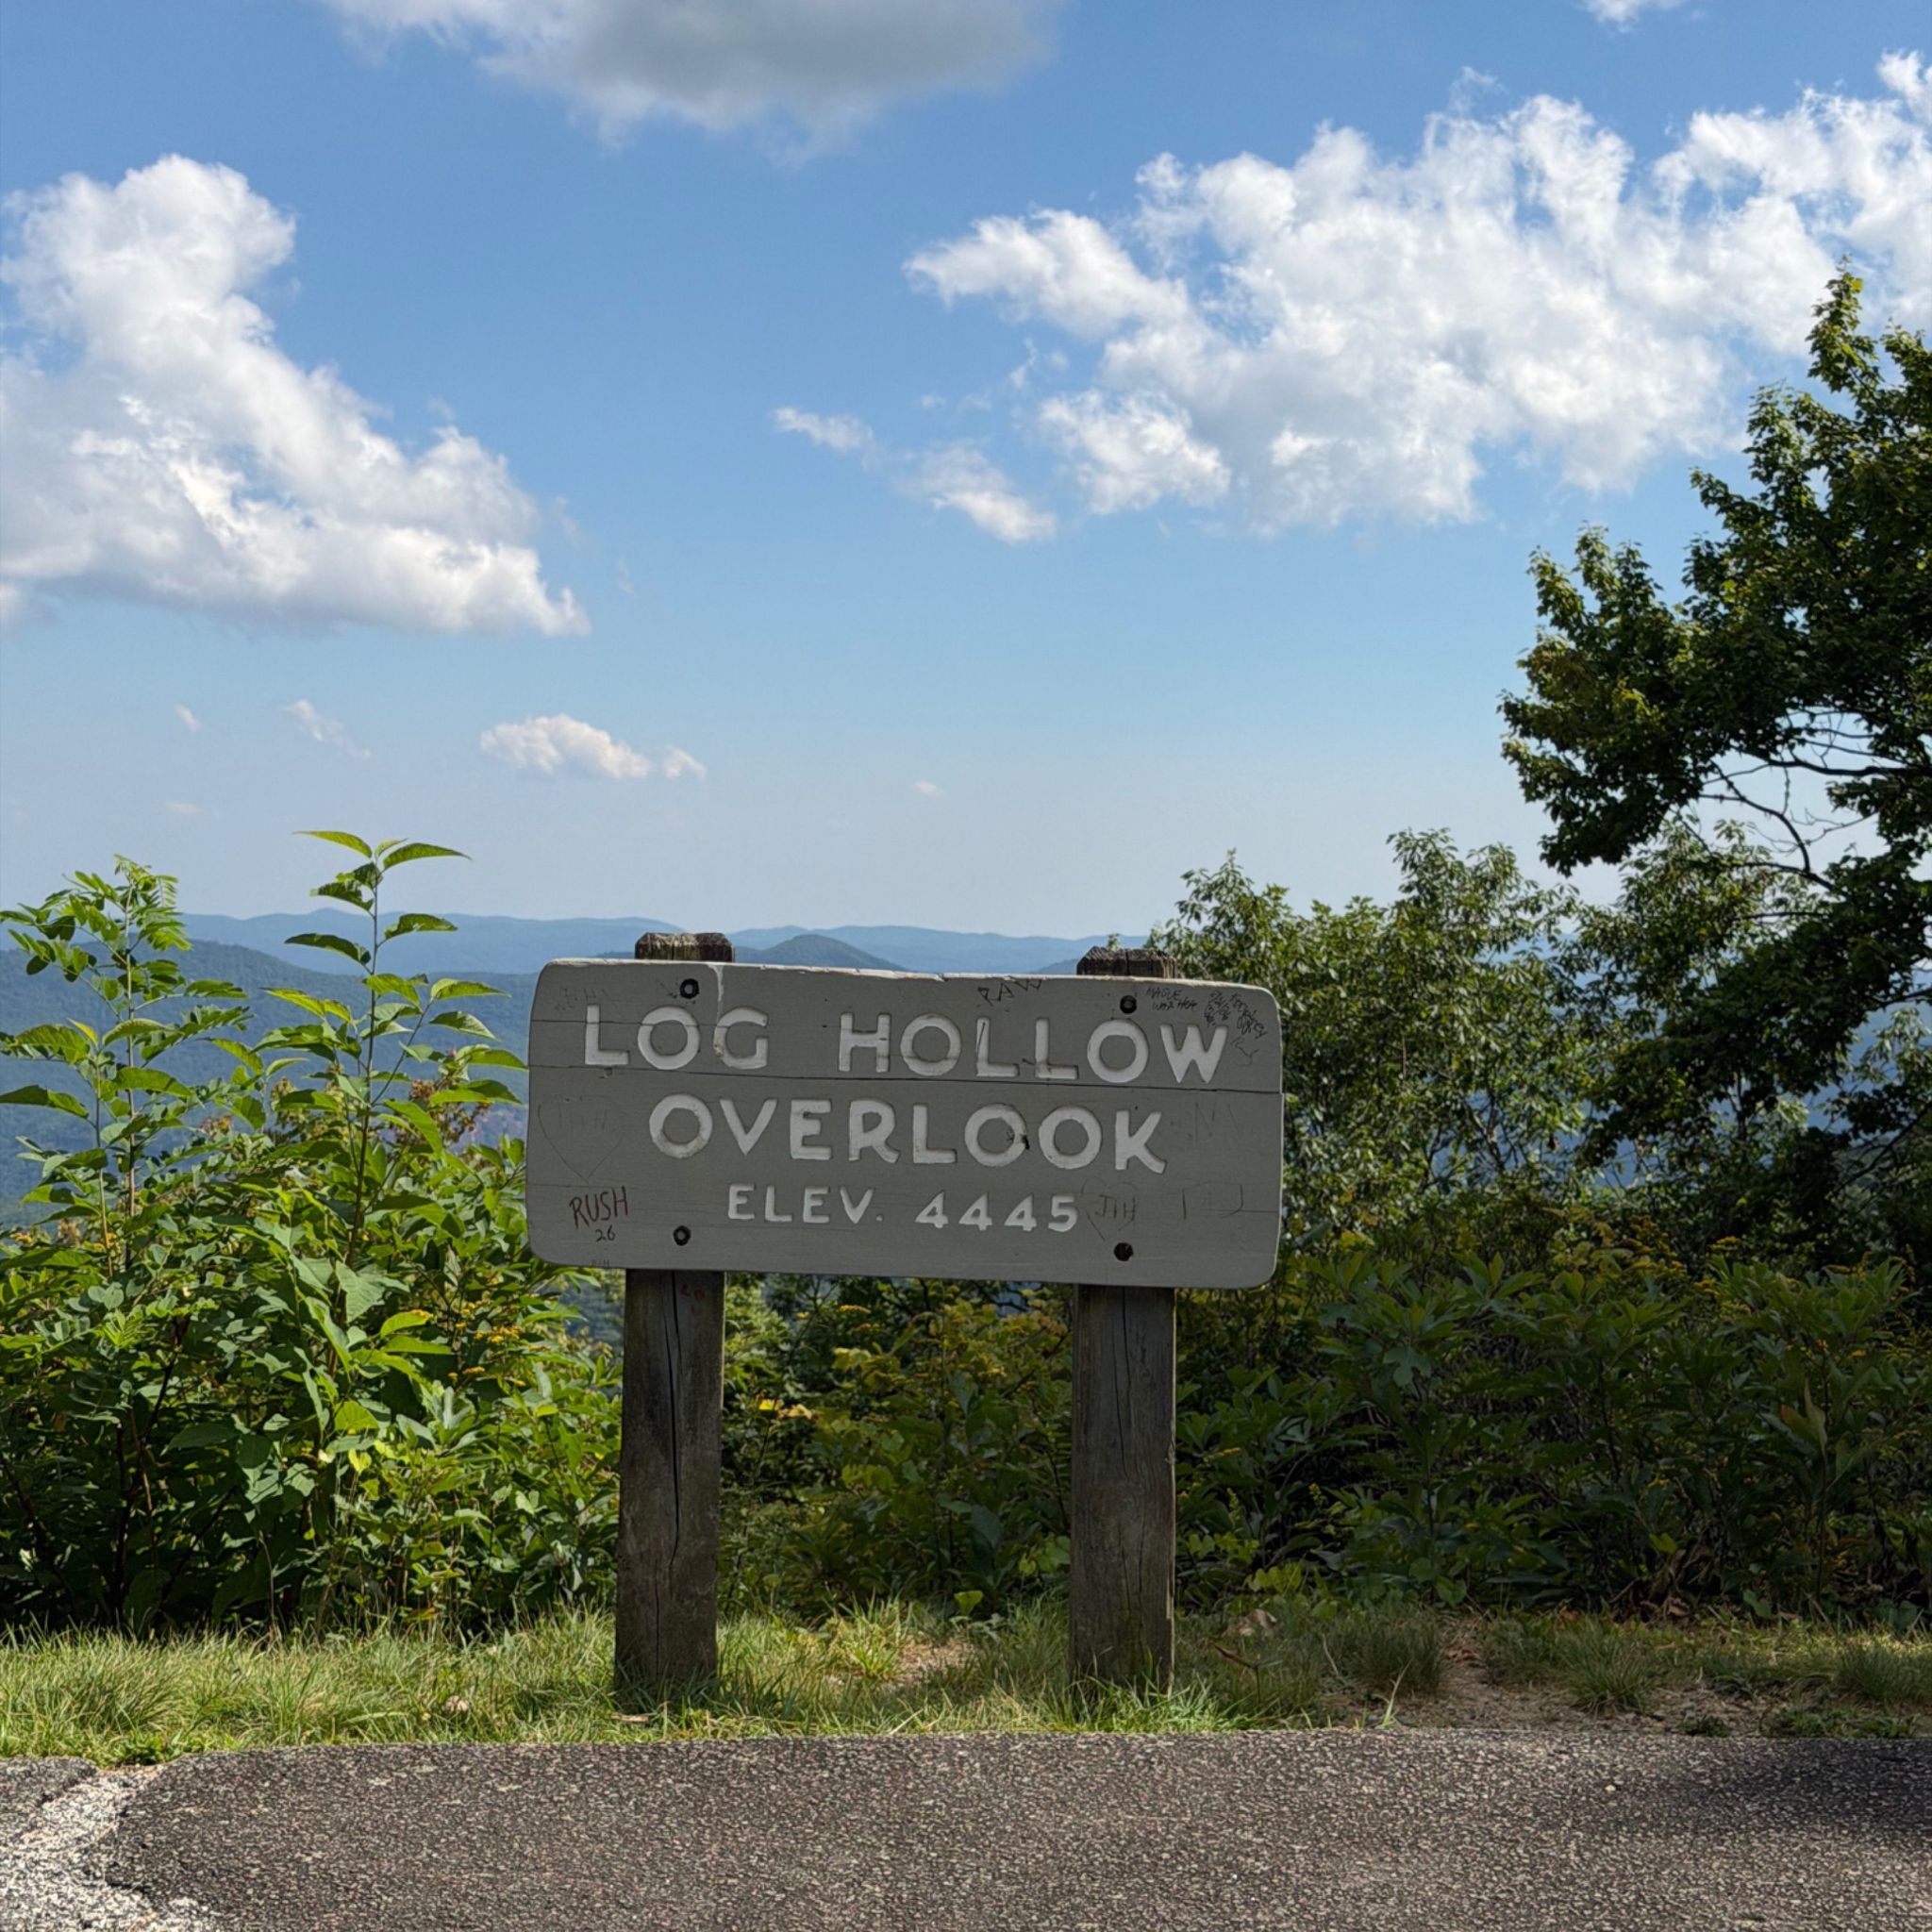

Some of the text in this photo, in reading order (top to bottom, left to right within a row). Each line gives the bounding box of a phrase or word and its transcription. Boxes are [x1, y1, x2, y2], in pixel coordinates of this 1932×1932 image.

[585, 1005, 769, 1070] LOG
[839, 1012, 1227, 1084] HOLLOW
[649, 1093, 1167, 1174] OVERLOOK
[569, 1186, 628, 1229] RUSH
[728, 1184, 1078, 1232] ELEV. 4445
[594, 1225, 616, 1242] 26
